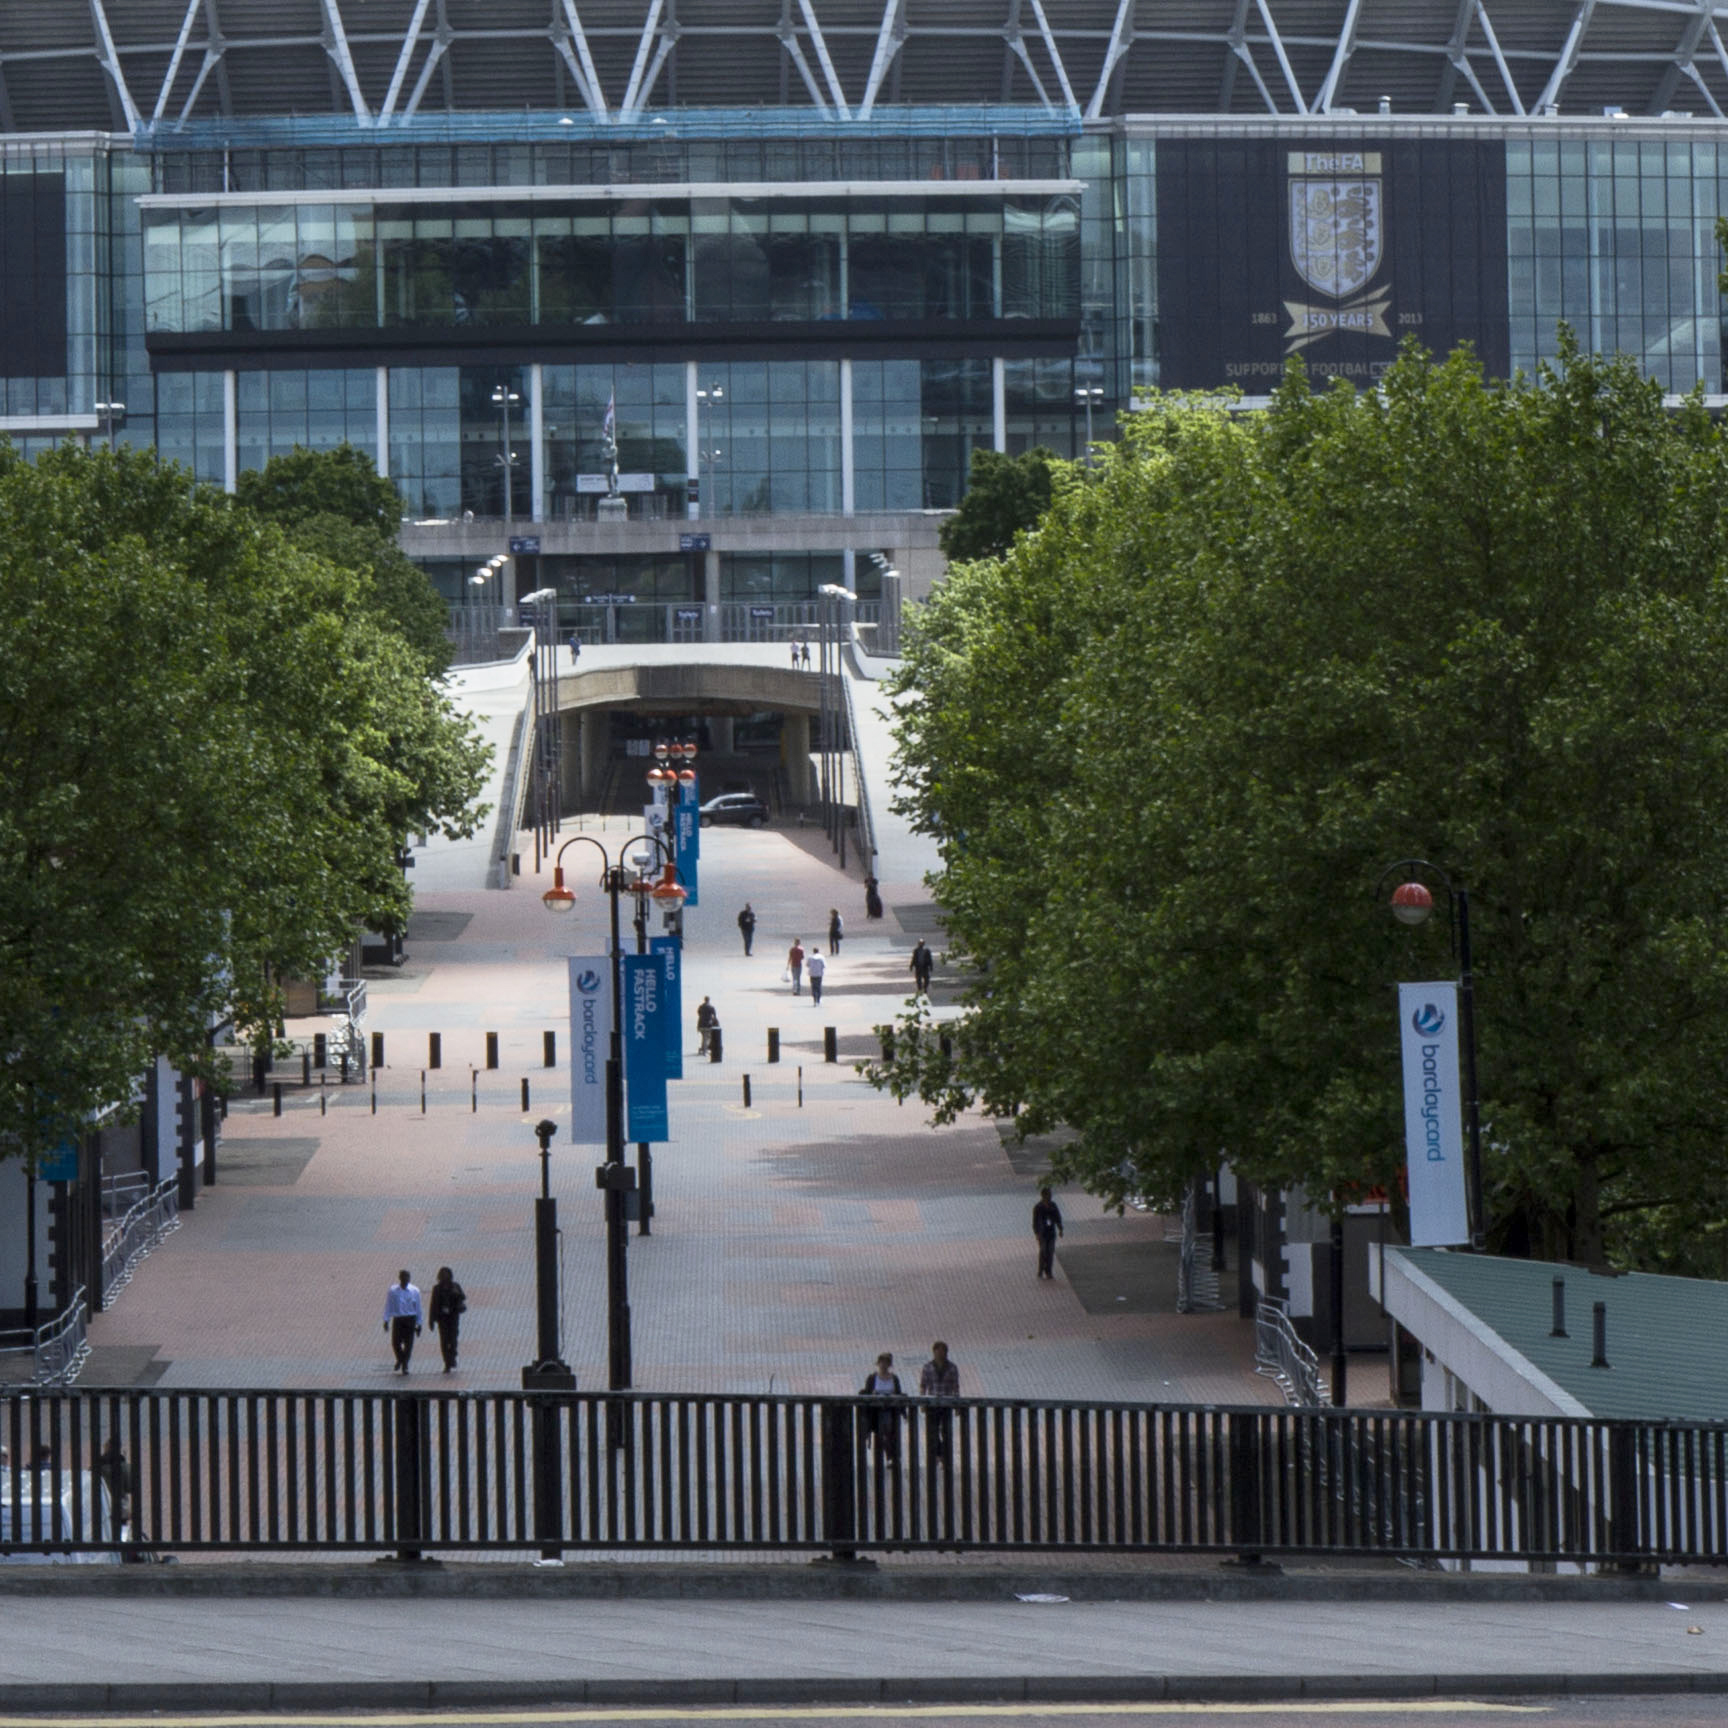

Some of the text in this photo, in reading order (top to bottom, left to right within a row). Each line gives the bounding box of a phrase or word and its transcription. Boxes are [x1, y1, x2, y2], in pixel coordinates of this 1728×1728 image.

[1330, 313, 1373, 328] YEARS
[633, 968, 646, 1041] FASTRACK
[644, 968, 657, 1013] HELLO
[580, 999, 598, 1085] barclaycard
[1421, 1043, 1446, 1163] barclaycard
